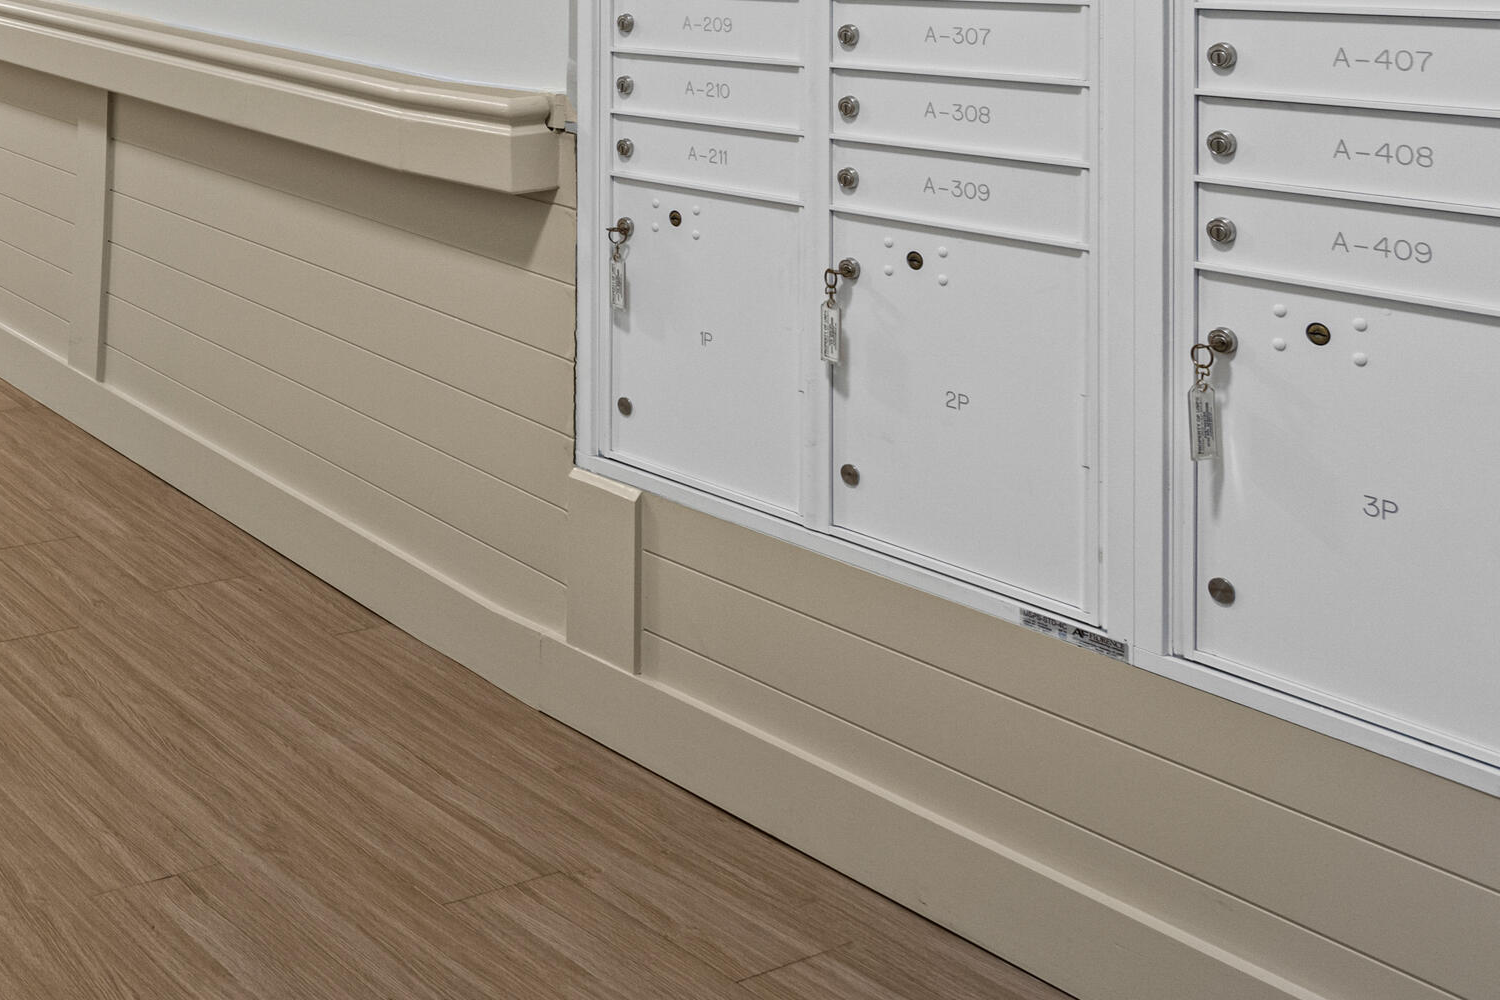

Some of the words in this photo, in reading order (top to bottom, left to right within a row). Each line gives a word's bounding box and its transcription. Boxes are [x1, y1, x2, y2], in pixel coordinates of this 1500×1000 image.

[683, 16, 732, 32] A-209
[925, 26, 991, 45] A-307
[1333, 48, 1433, 72] A-407
[685, 81, 730, 99] A-210
[924, 102, 990, 124] A-308
[688, 148, 728, 165] A-211
[1333, 139, 1433, 168] A-408
[924, 177, 990, 201] A-309
[1332, 232, 1432, 263] A-409
[700, 331, 712, 346] 1P
[946, 391, 970, 410] 2P
[1363, 495, 1398, 519] 3P
